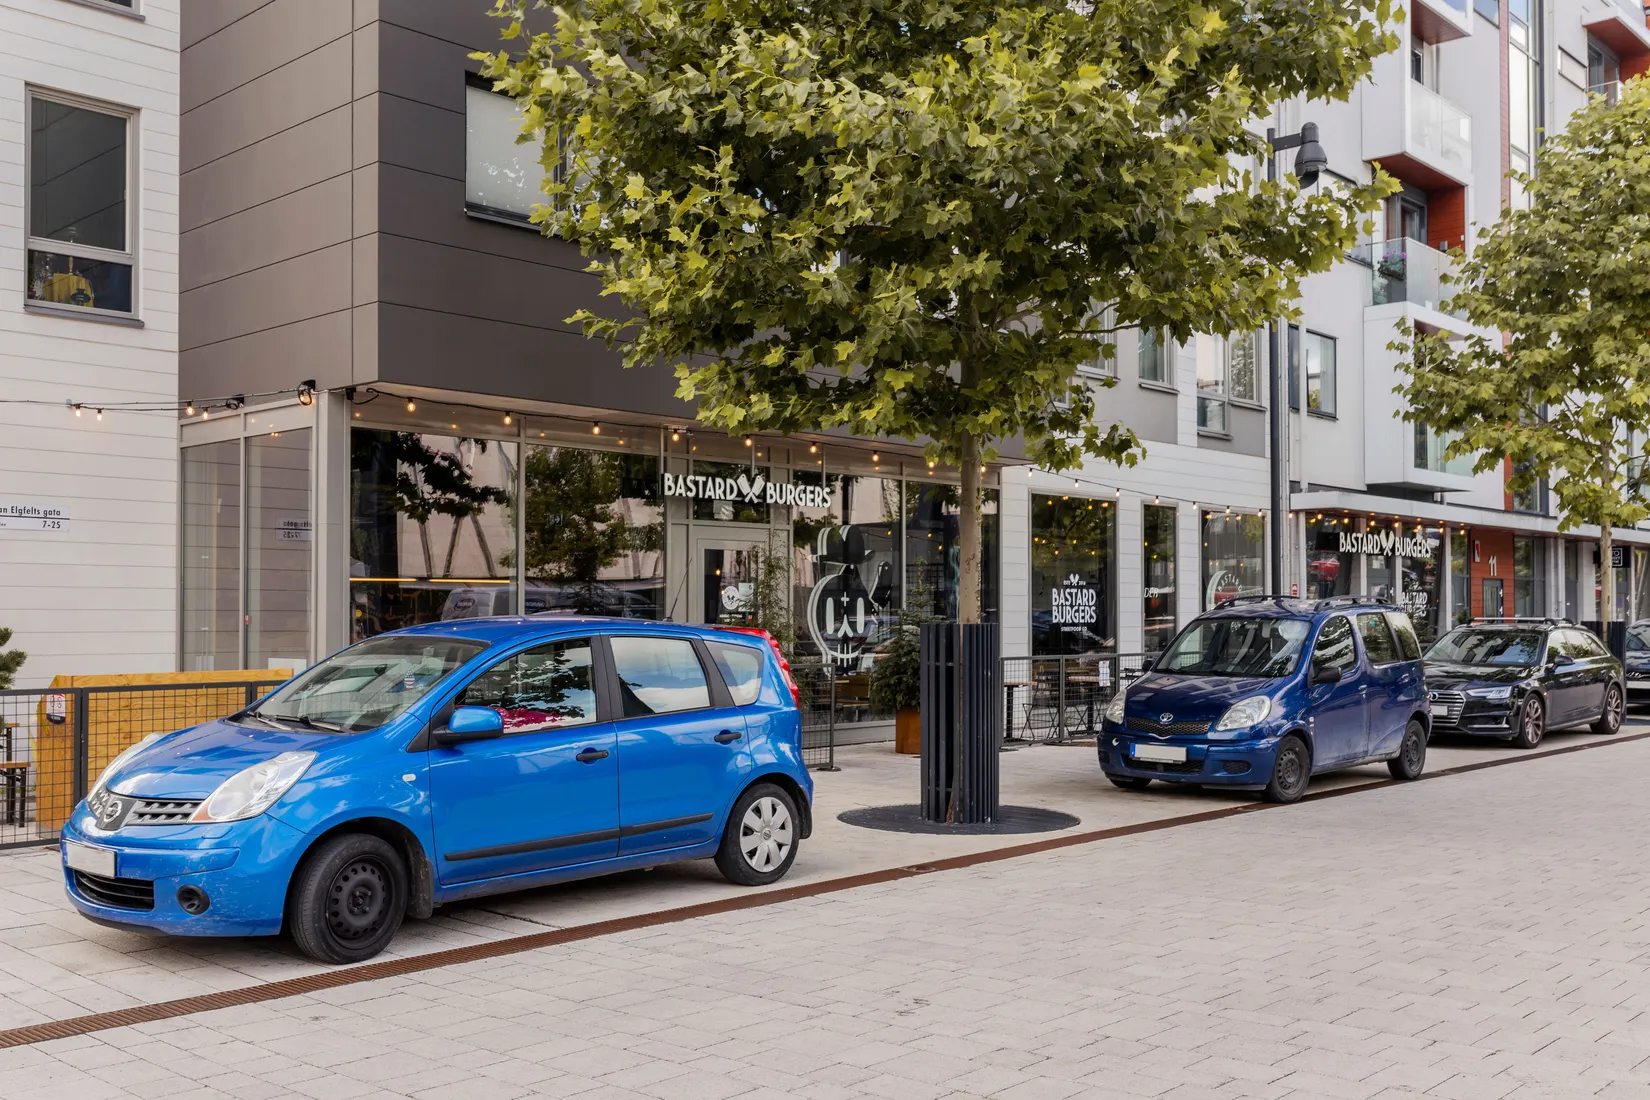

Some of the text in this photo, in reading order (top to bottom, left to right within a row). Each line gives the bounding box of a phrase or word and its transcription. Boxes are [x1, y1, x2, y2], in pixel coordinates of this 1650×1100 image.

[664, 473, 832, 508] BASTARD BURGERS
[11, 506, 41, 517] Elgfelts
[43, 509, 61, 518] gata
[42, 520, 61, 529] 7-25
[1339, 531, 1431, 558] BASTARD BURGERS
[1488, 555, 1497, 577] 11
[1217, 573, 1243, 592] BASTARD
[1052, 588, 1097, 606] BASTARD
[1052, 606, 1097, 623] BURGERS
